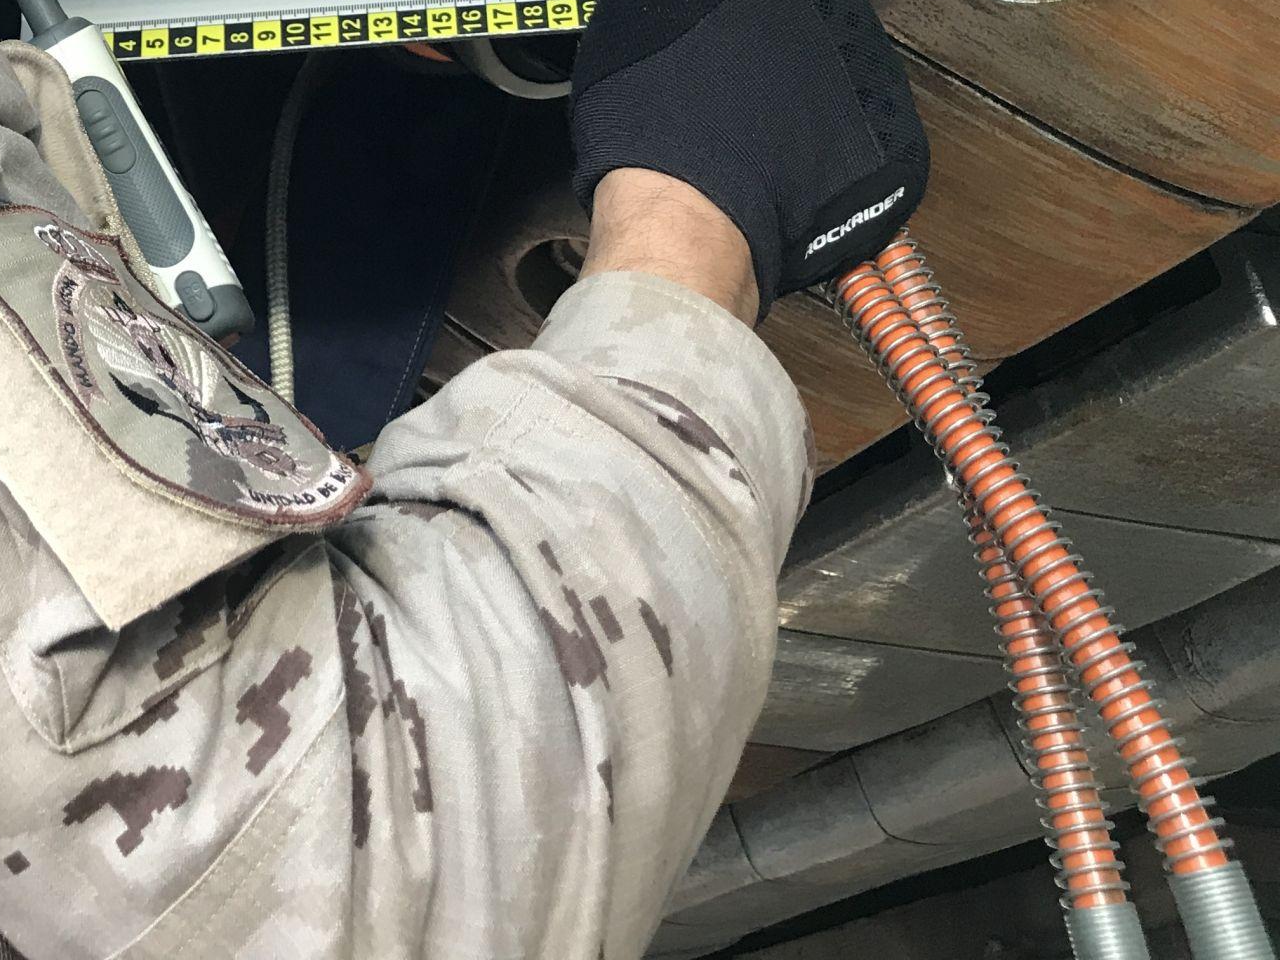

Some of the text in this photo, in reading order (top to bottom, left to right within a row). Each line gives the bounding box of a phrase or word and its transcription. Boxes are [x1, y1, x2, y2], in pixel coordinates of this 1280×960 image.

[118, 40, 137, 51] 4
[146, 38, 164, 49] 5
[174, 36, 194, 47] 6
[202, 35, 221, 45] 7
[230, 32, 250, 44] 8
[257, 30, 277, 41] 9
[286, 22, 307, 44] 10
[312, 21, 332, 41] 11
[341, 18, 361, 40] 12
[373, 16, 393, 38] 13
[402, 13, 423, 36] 14
[432, 11, 452, 34] 15
[462, 9, 482, 32] 16
[493, 8, 514, 29] 17
[523, 5, 544, 27] 18
[551, 3, 572, 25] 19
